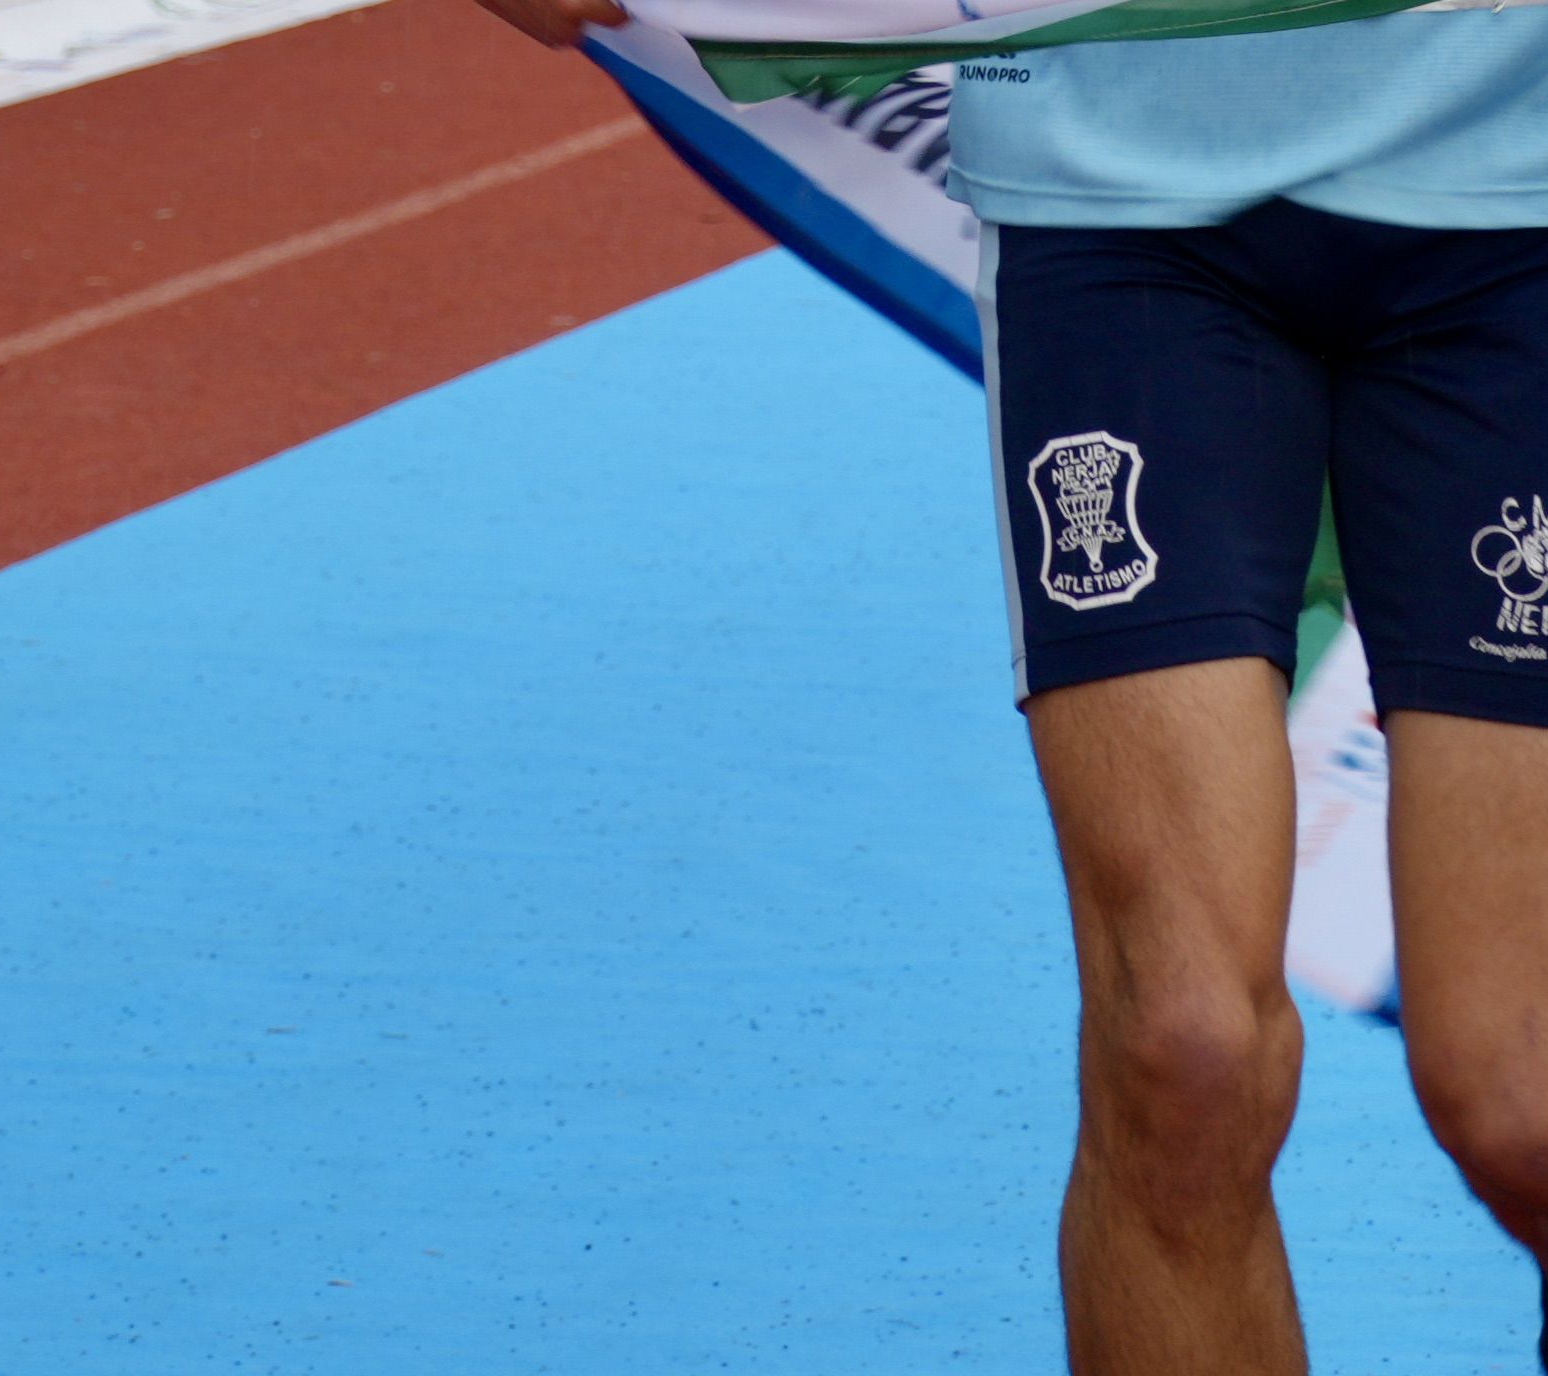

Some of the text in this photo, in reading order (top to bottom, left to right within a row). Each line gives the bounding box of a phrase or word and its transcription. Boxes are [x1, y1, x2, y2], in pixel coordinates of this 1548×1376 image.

[1054, 442, 1107, 467] CLUB
[1052, 460, 1114, 485] NERJA
[1053, 558, 1147, 594] ATLETISMO
